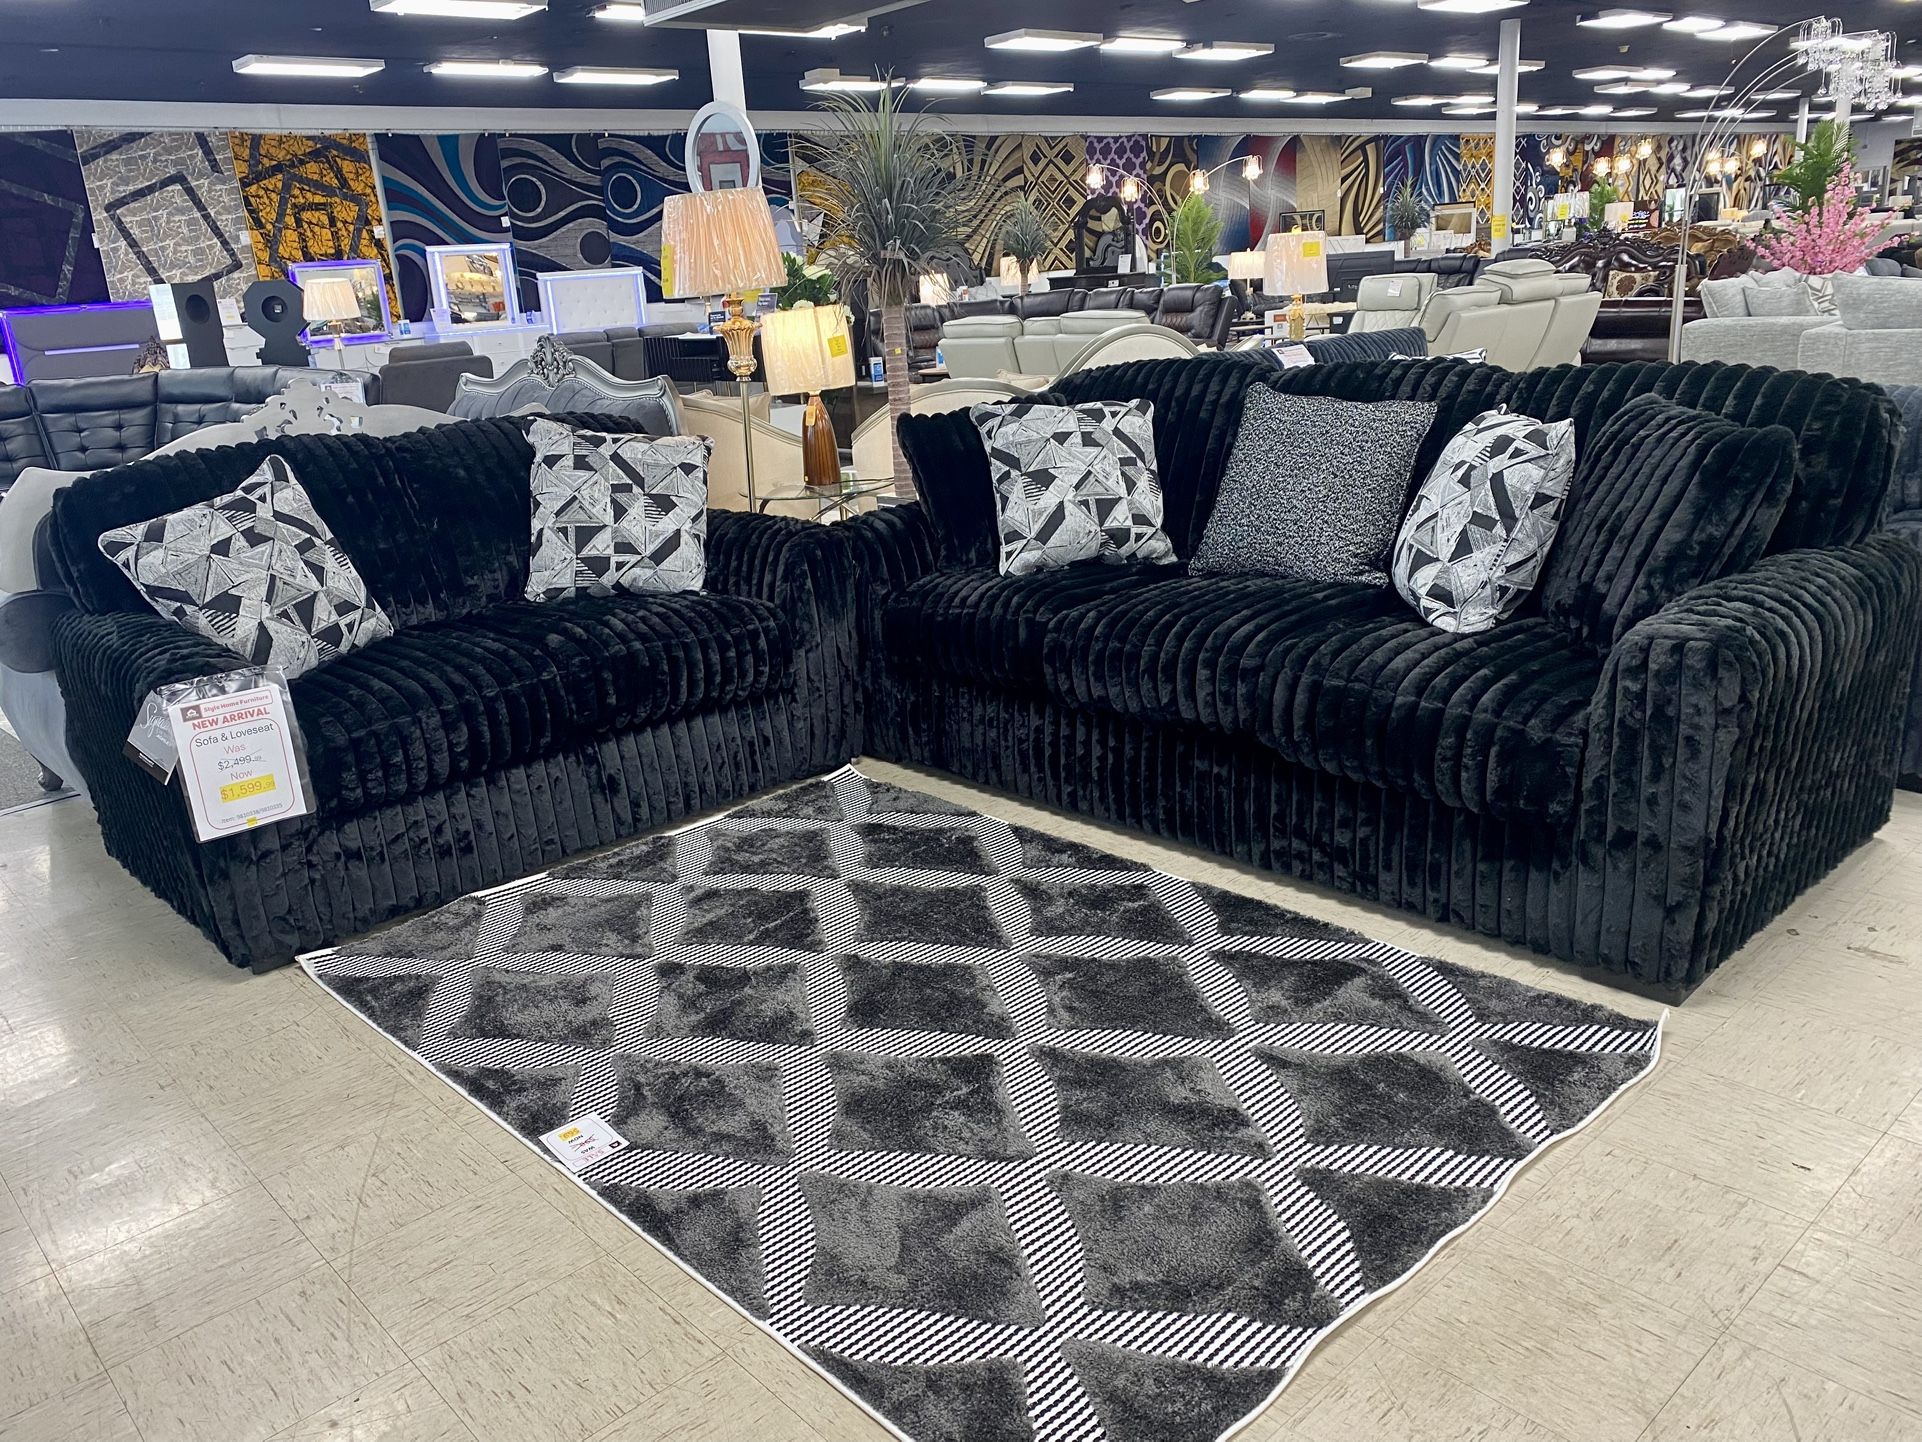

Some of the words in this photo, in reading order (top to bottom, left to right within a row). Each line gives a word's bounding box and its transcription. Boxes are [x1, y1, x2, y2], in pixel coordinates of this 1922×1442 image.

[203, 705, 220, 713] Style
[221, 700, 240, 710] Home
[240, 695, 269, 705] Furniture
[192, 717, 219, 731] NEW
[222, 707, 271, 726] ARRIVAL
[195, 734, 219, 748] Sofa
[221, 732, 229, 742] &
[230, 723, 274, 740] Loveseat
[223, 744, 247, 755] Was
[230, 769, 253, 781] Now
